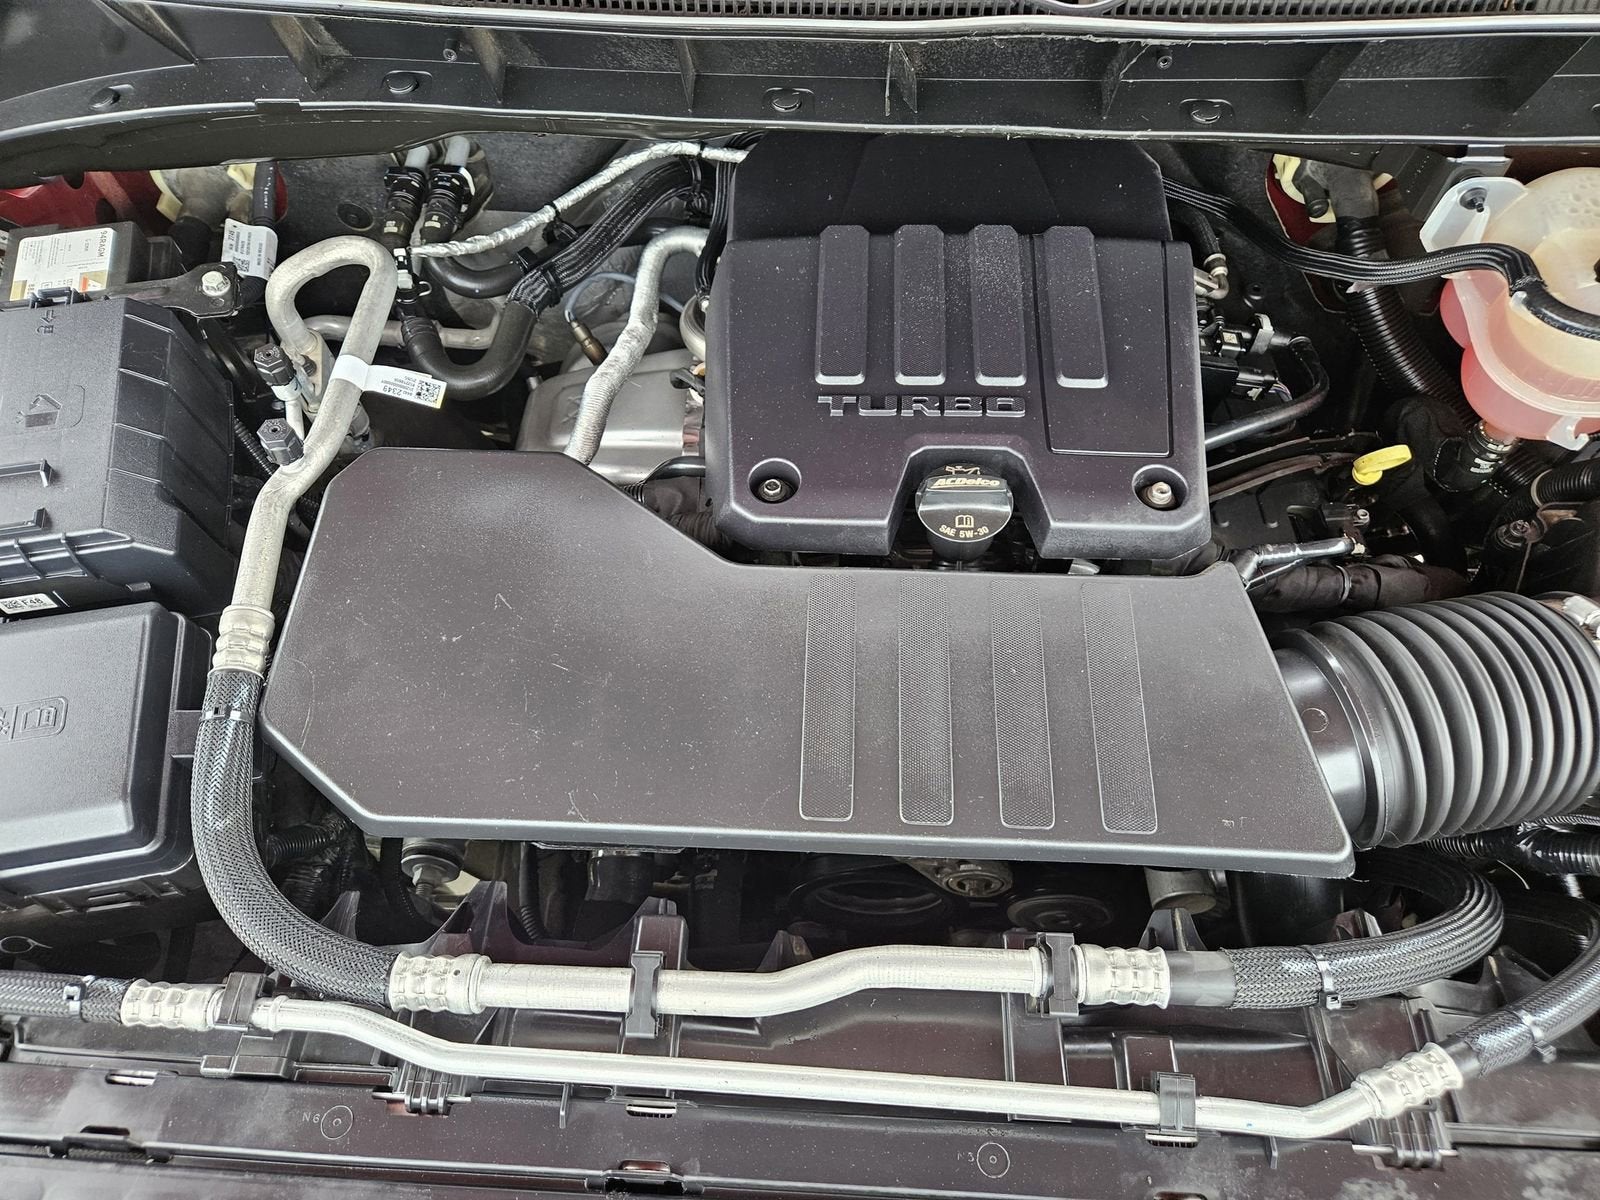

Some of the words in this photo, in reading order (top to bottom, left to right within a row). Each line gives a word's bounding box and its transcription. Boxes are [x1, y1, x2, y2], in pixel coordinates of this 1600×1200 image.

[97, 230, 108, 258] 94RAGM
[382, 385, 402, 396] 2349
[817, 395, 1026, 417] TURBO
[930, 477, 1000, 488] ACDelco
[939, 524, 957, 537] SAE
[959, 525, 989, 538] 5W-30
